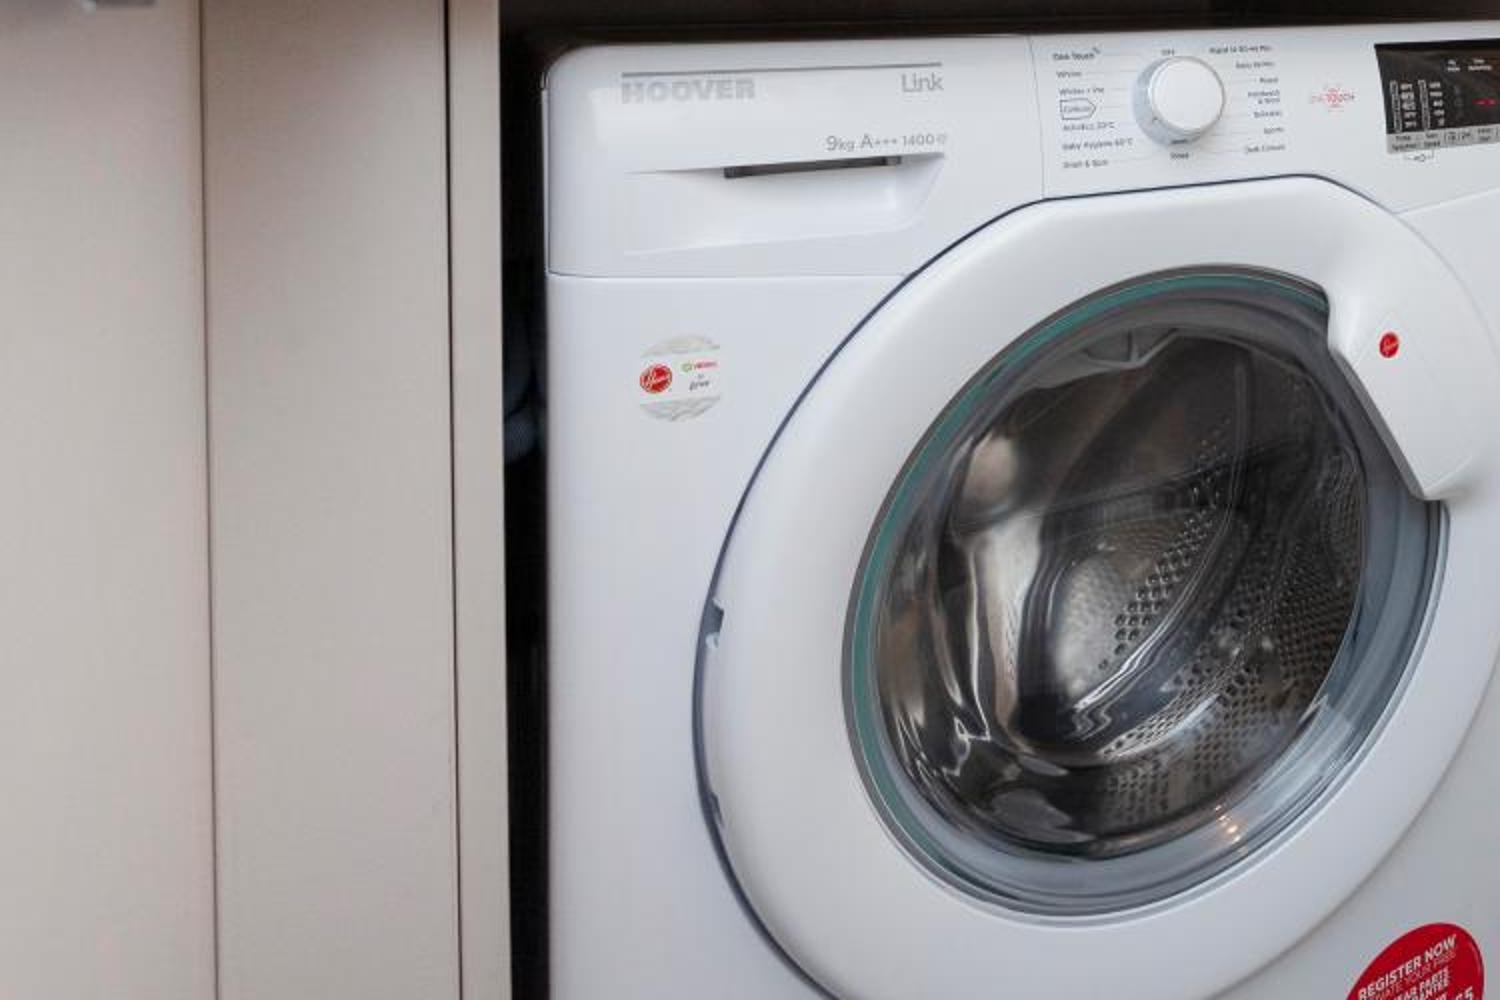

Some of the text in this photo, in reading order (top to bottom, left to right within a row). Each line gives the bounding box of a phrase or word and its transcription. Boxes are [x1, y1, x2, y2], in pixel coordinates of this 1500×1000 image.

[621, 79, 755, 104] HOOVER
[901, 71, 944, 92] Link
[825, 133, 934, 152] 9kg A+++ 1400
[1358, 955, 1421, 1000] REGISTER
[1423, 933, 1457, 963] NOW
